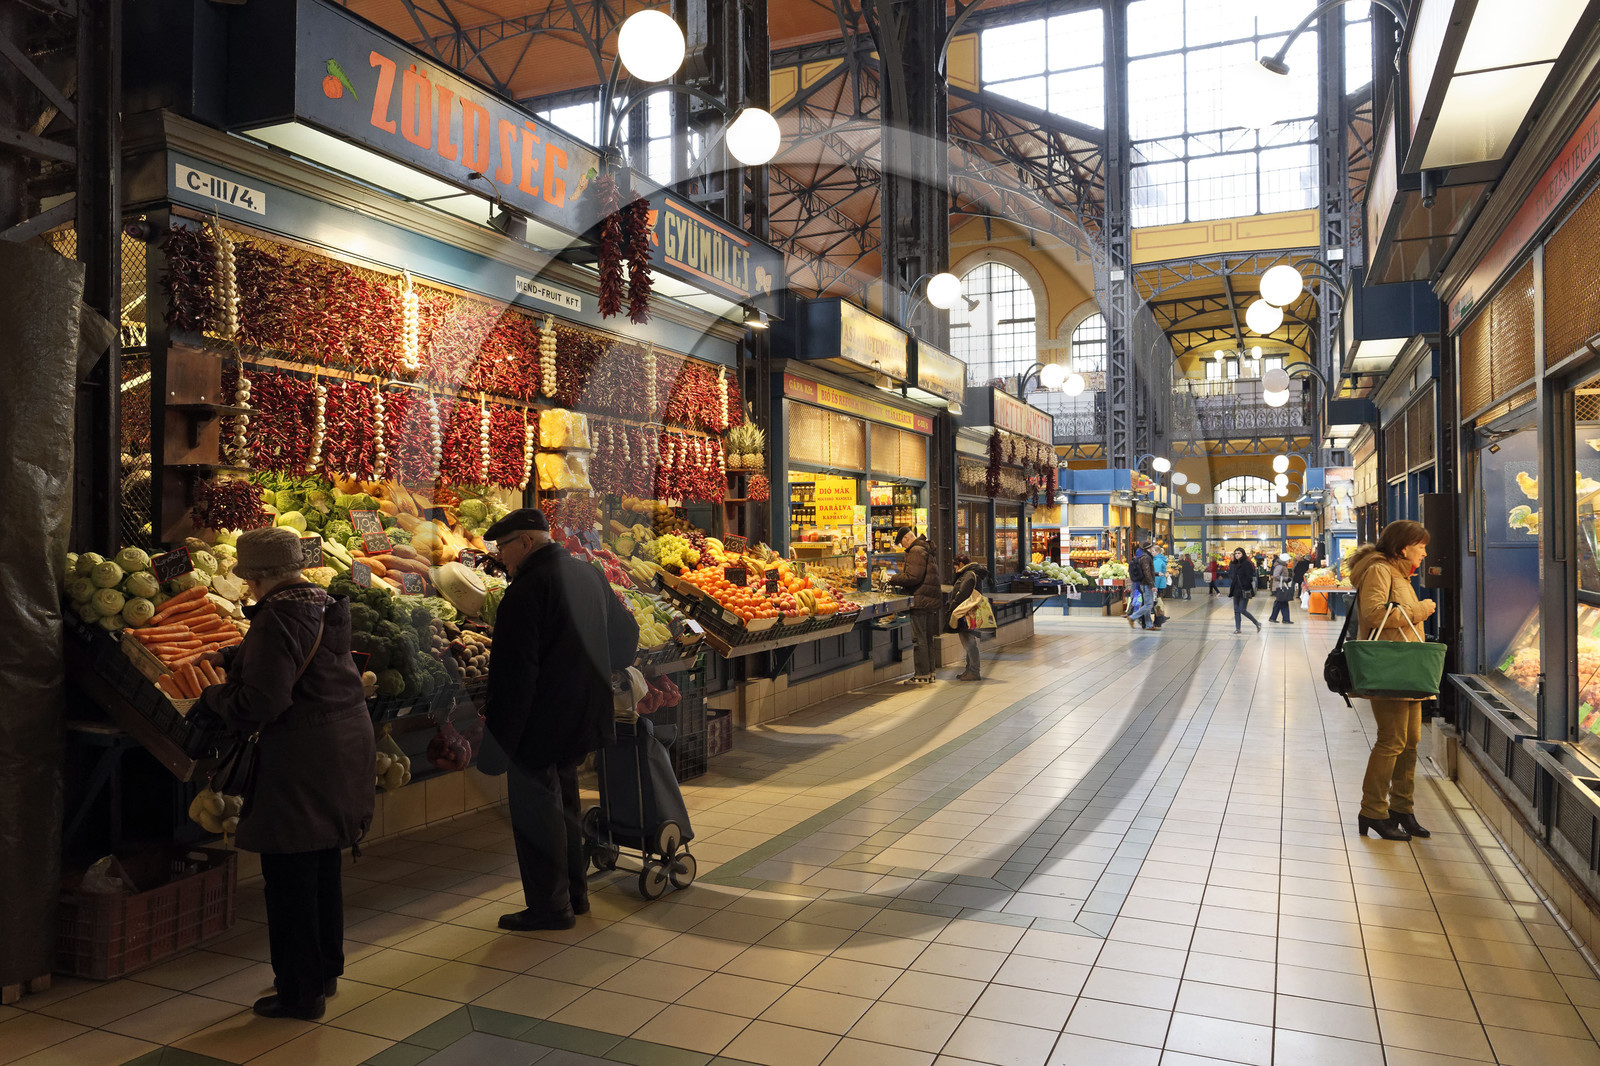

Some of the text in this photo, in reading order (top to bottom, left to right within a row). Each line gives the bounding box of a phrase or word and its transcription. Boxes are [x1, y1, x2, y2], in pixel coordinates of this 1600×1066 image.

[369, 51, 568, 209] ZÖLDSÉG
[186, 170, 257, 211] C-III/4.
[664, 210, 751, 292] GYÜMÖLCS
[516, 277, 562, 302] MEND-FRUIT
[819, 486, 850, 495] DIÓ MÁK
